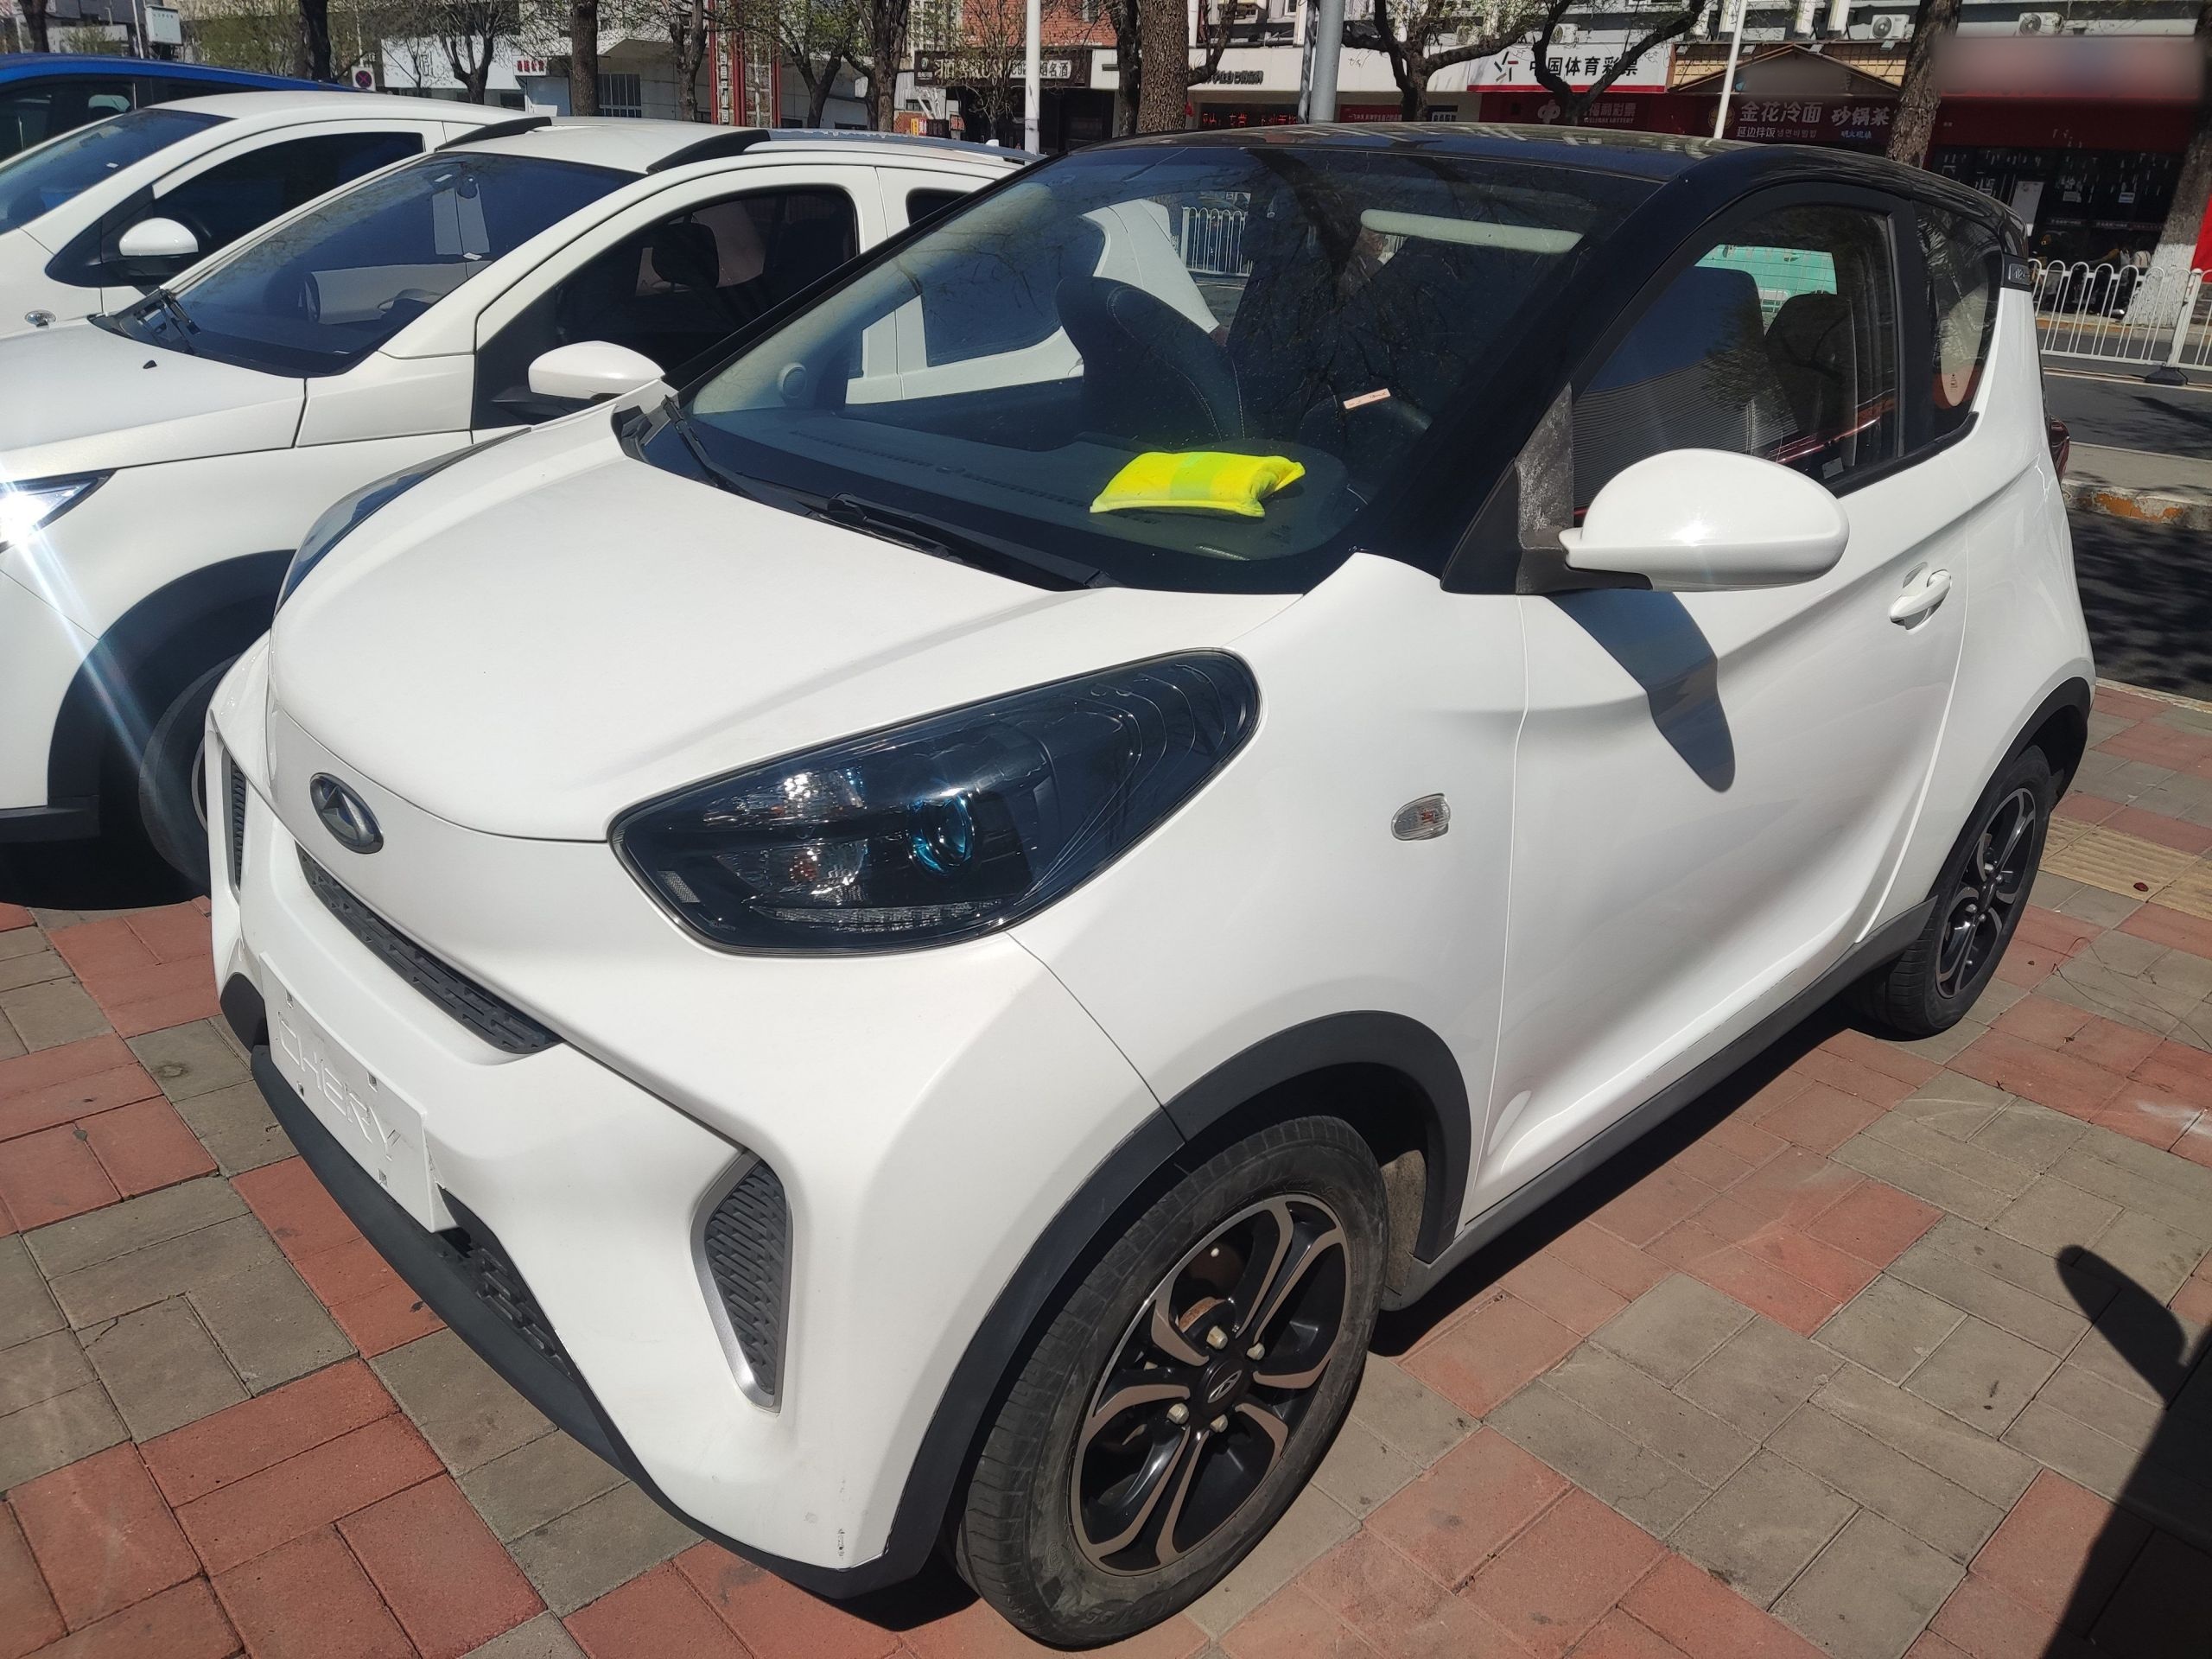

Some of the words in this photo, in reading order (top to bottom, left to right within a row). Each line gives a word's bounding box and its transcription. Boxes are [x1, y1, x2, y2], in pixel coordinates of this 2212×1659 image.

[1739, 101, 1824, 124] 金花冷面
[1831, 105, 1891, 127] 砂锅菜
[1736, 126, 1776, 138] 延边拌饭
[277, 1011, 403, 1161] CHERY
